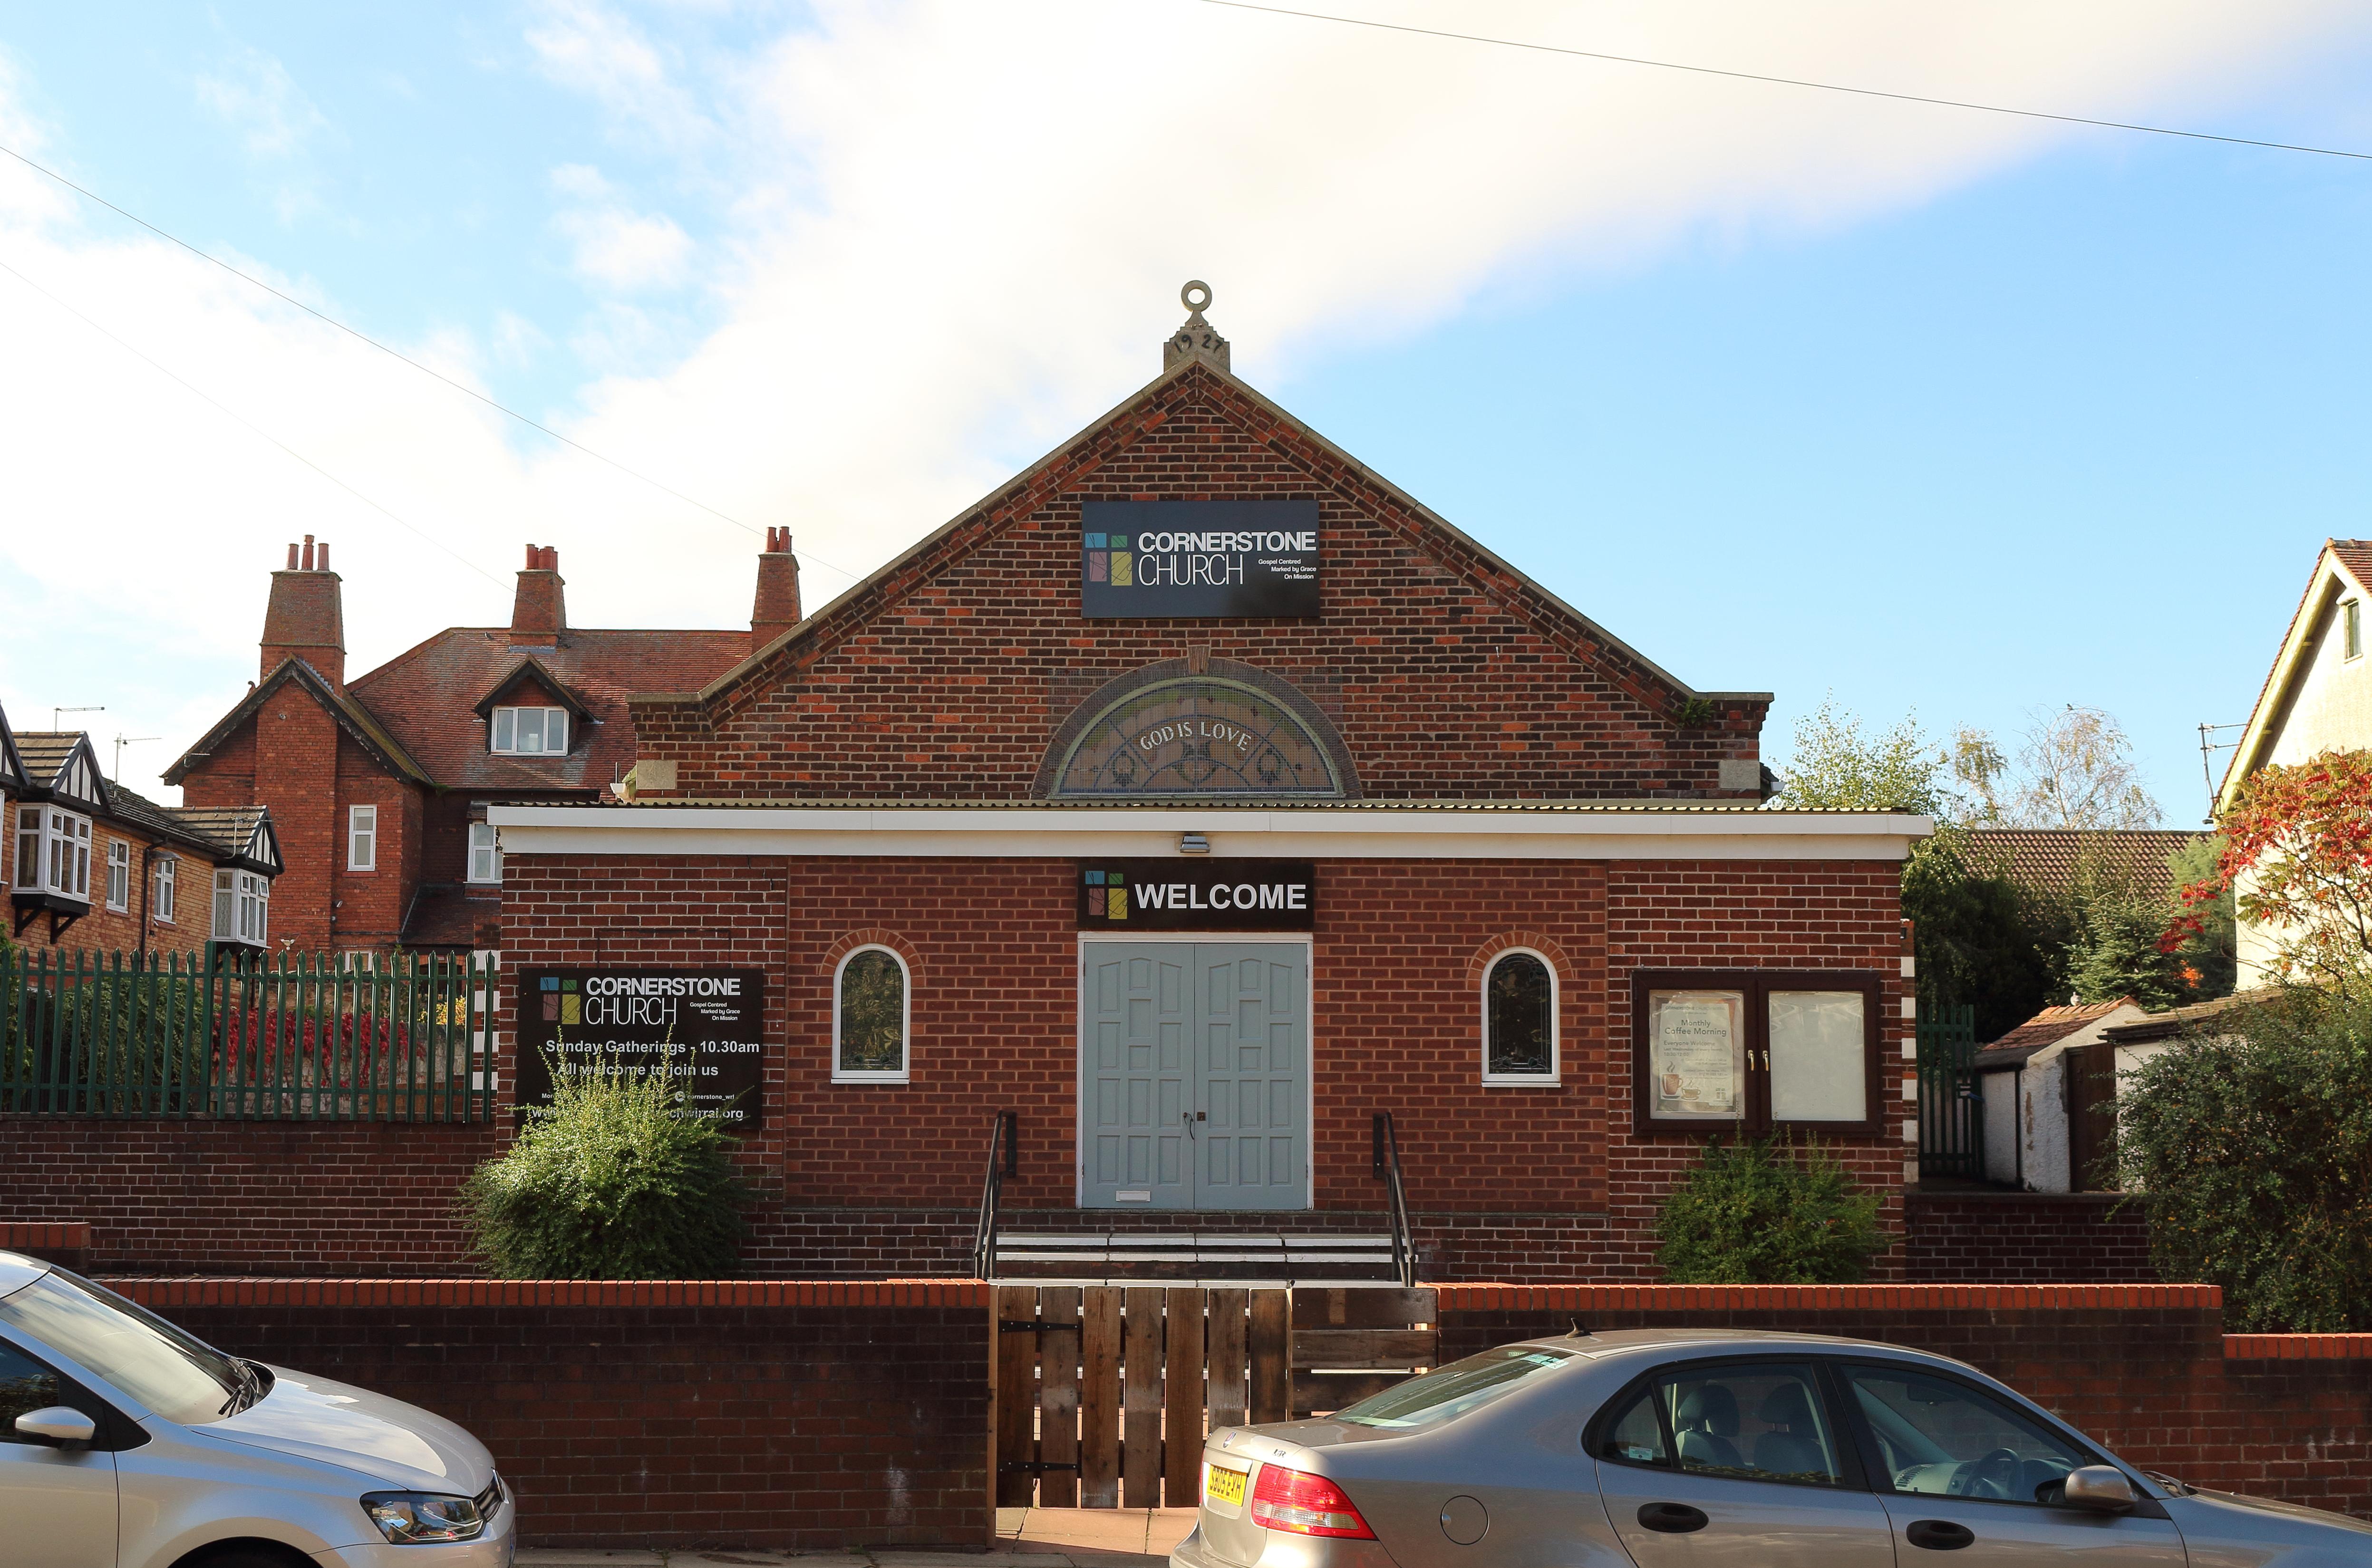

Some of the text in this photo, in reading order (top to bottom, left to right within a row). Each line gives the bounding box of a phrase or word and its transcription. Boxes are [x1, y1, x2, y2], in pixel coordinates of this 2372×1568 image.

[1138, 531, 1317, 552] CORNERSTONE
[1138, 554, 1243, 586] CHURCH
[1141, 721, 1251, 751] GOD IS LOVE
[1135, 883, 1307, 909] WELCOME
[586, 977, 741, 996] CORNERSTONE
[586, 997, 677, 1025] CHURCH
[1681, 1020, 1711, 1028] Monthly
[1694, 1028, 1727, 1037] Morning
[546, 1040, 601, 1055] Sunday
[606, 1040, 686, 1056] Gatherings
[700, 1041, 759, 1053] 10.30am
[669, 1064, 696, 1078] join
[702, 1066, 718, 1076] us
[1210, 1467, 1242, 1500] SB05 EYH
